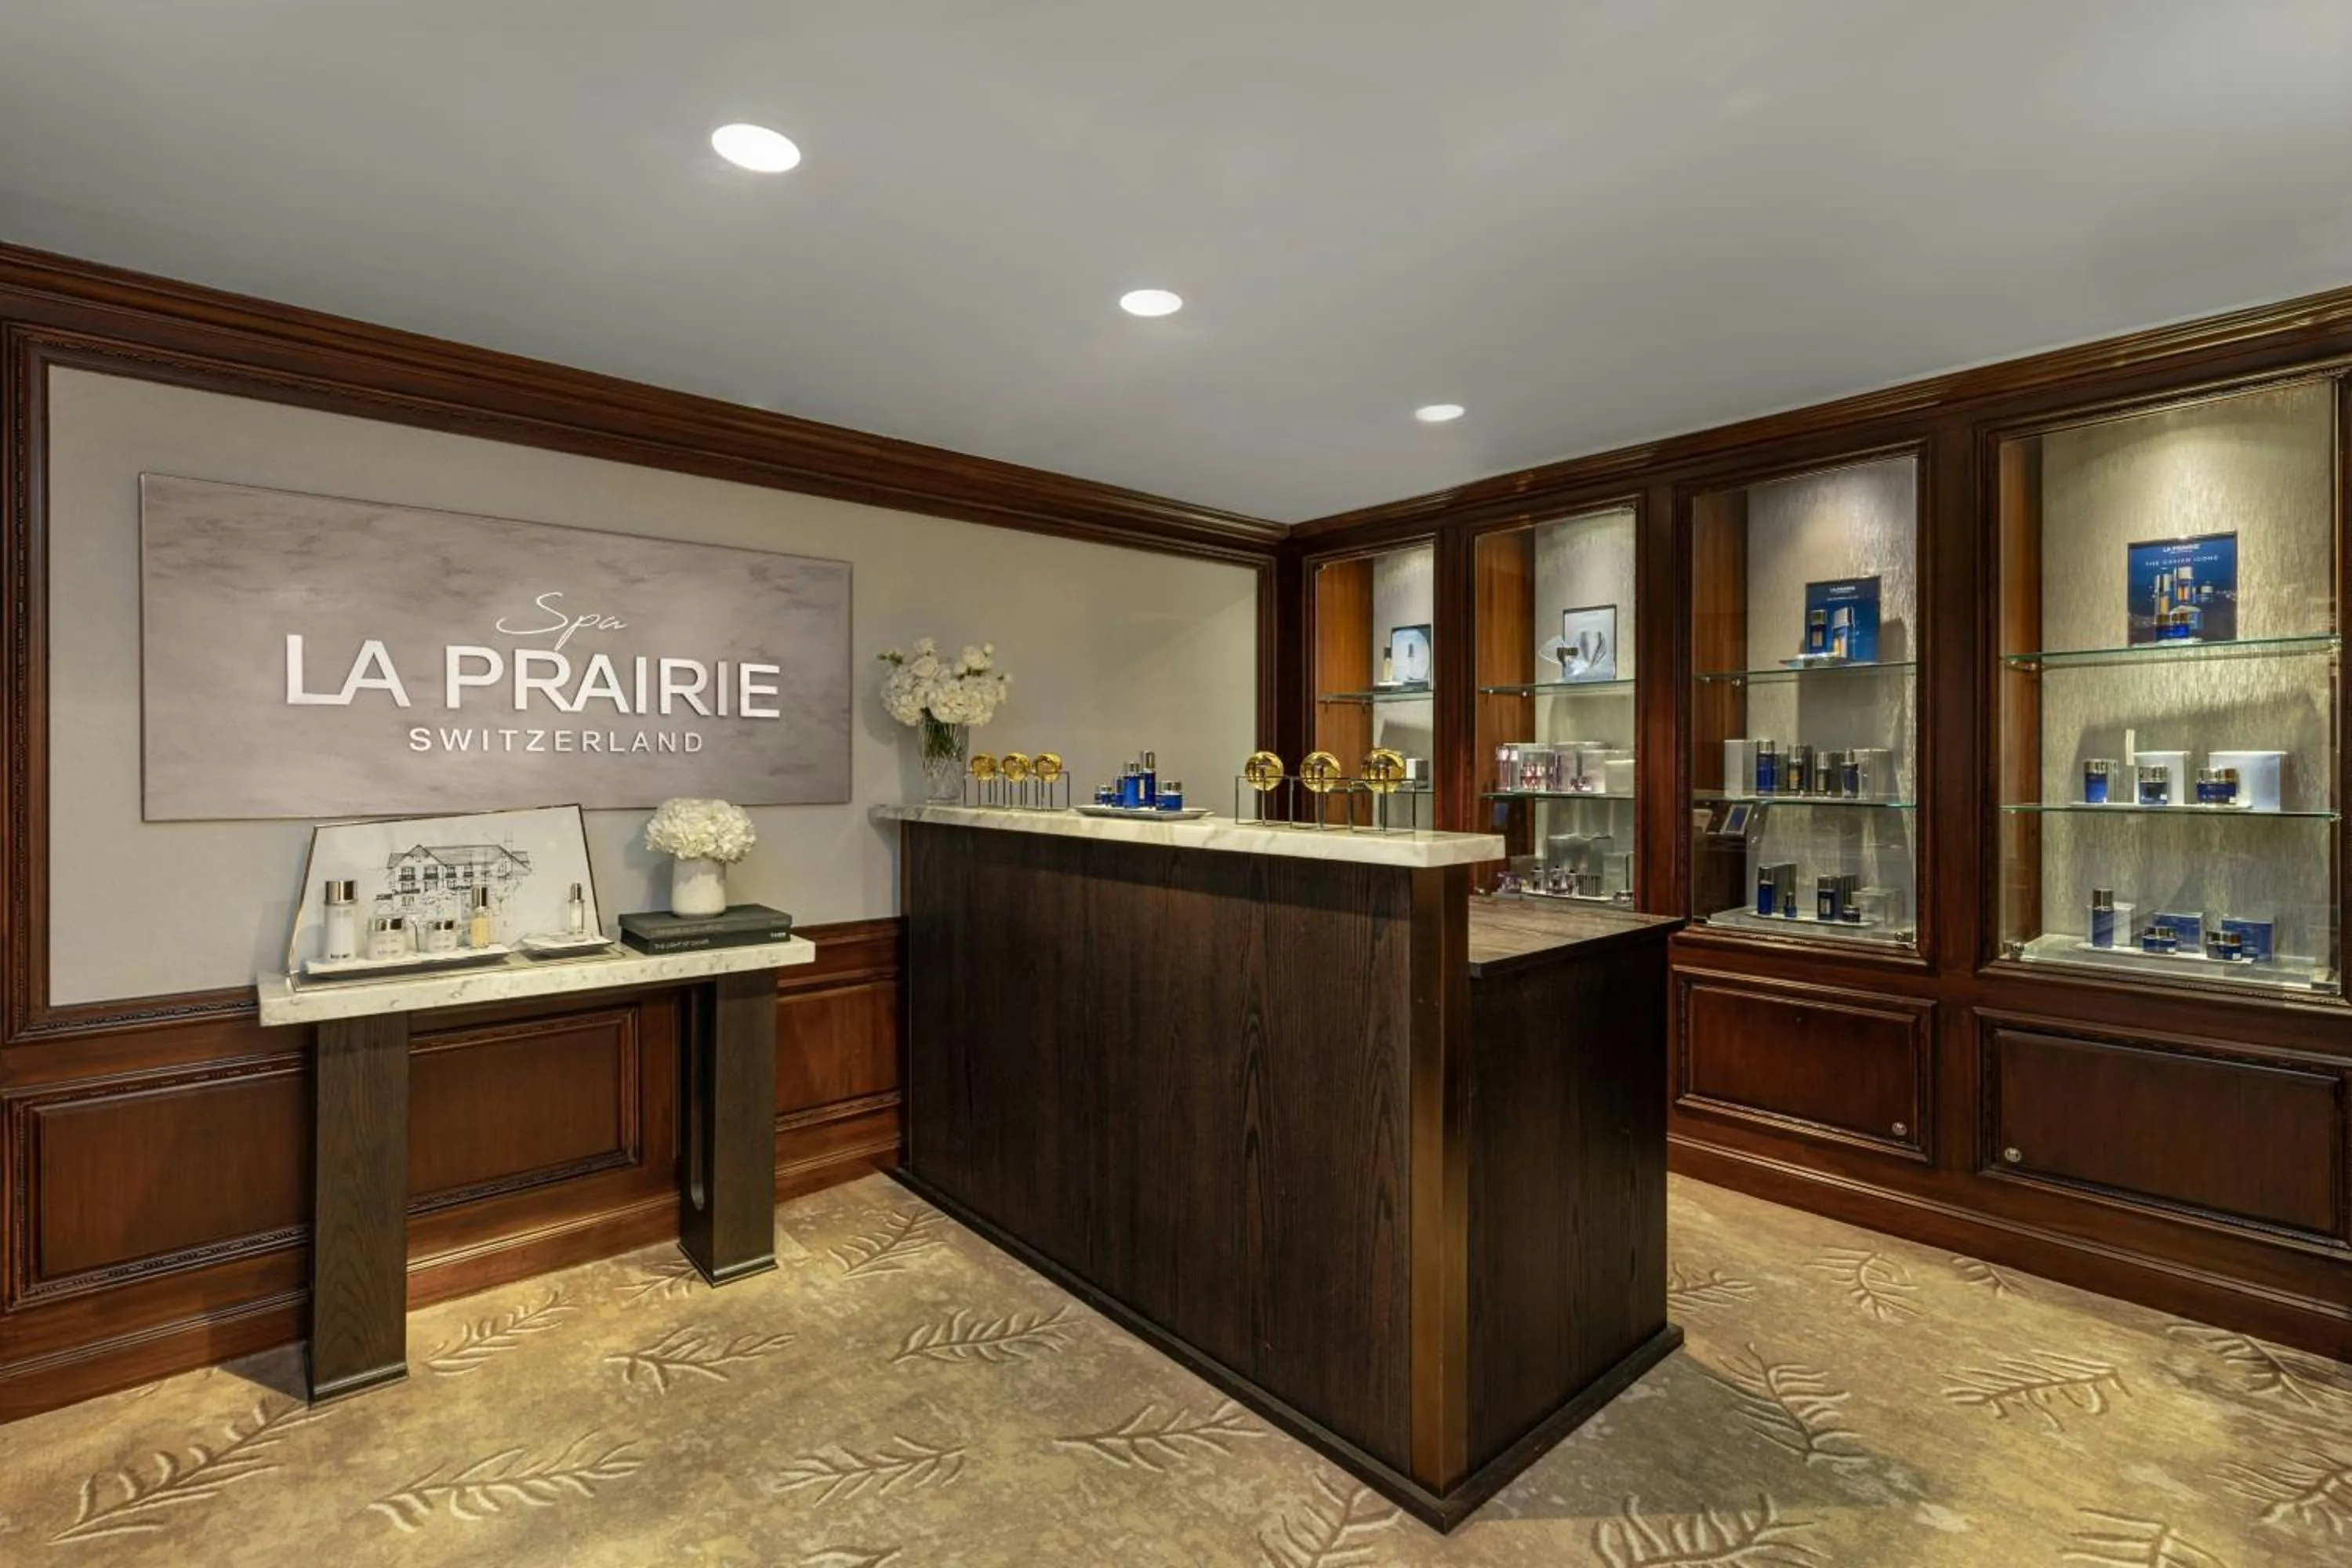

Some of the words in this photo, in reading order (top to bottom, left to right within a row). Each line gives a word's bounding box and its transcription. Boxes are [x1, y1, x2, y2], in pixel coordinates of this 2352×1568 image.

[495, 592, 629, 652] Spa
[286, 634, 412, 707] LA
[445, 644, 780, 718] PRAIRIE
[408, 726, 703, 753] SWITZERLAND
